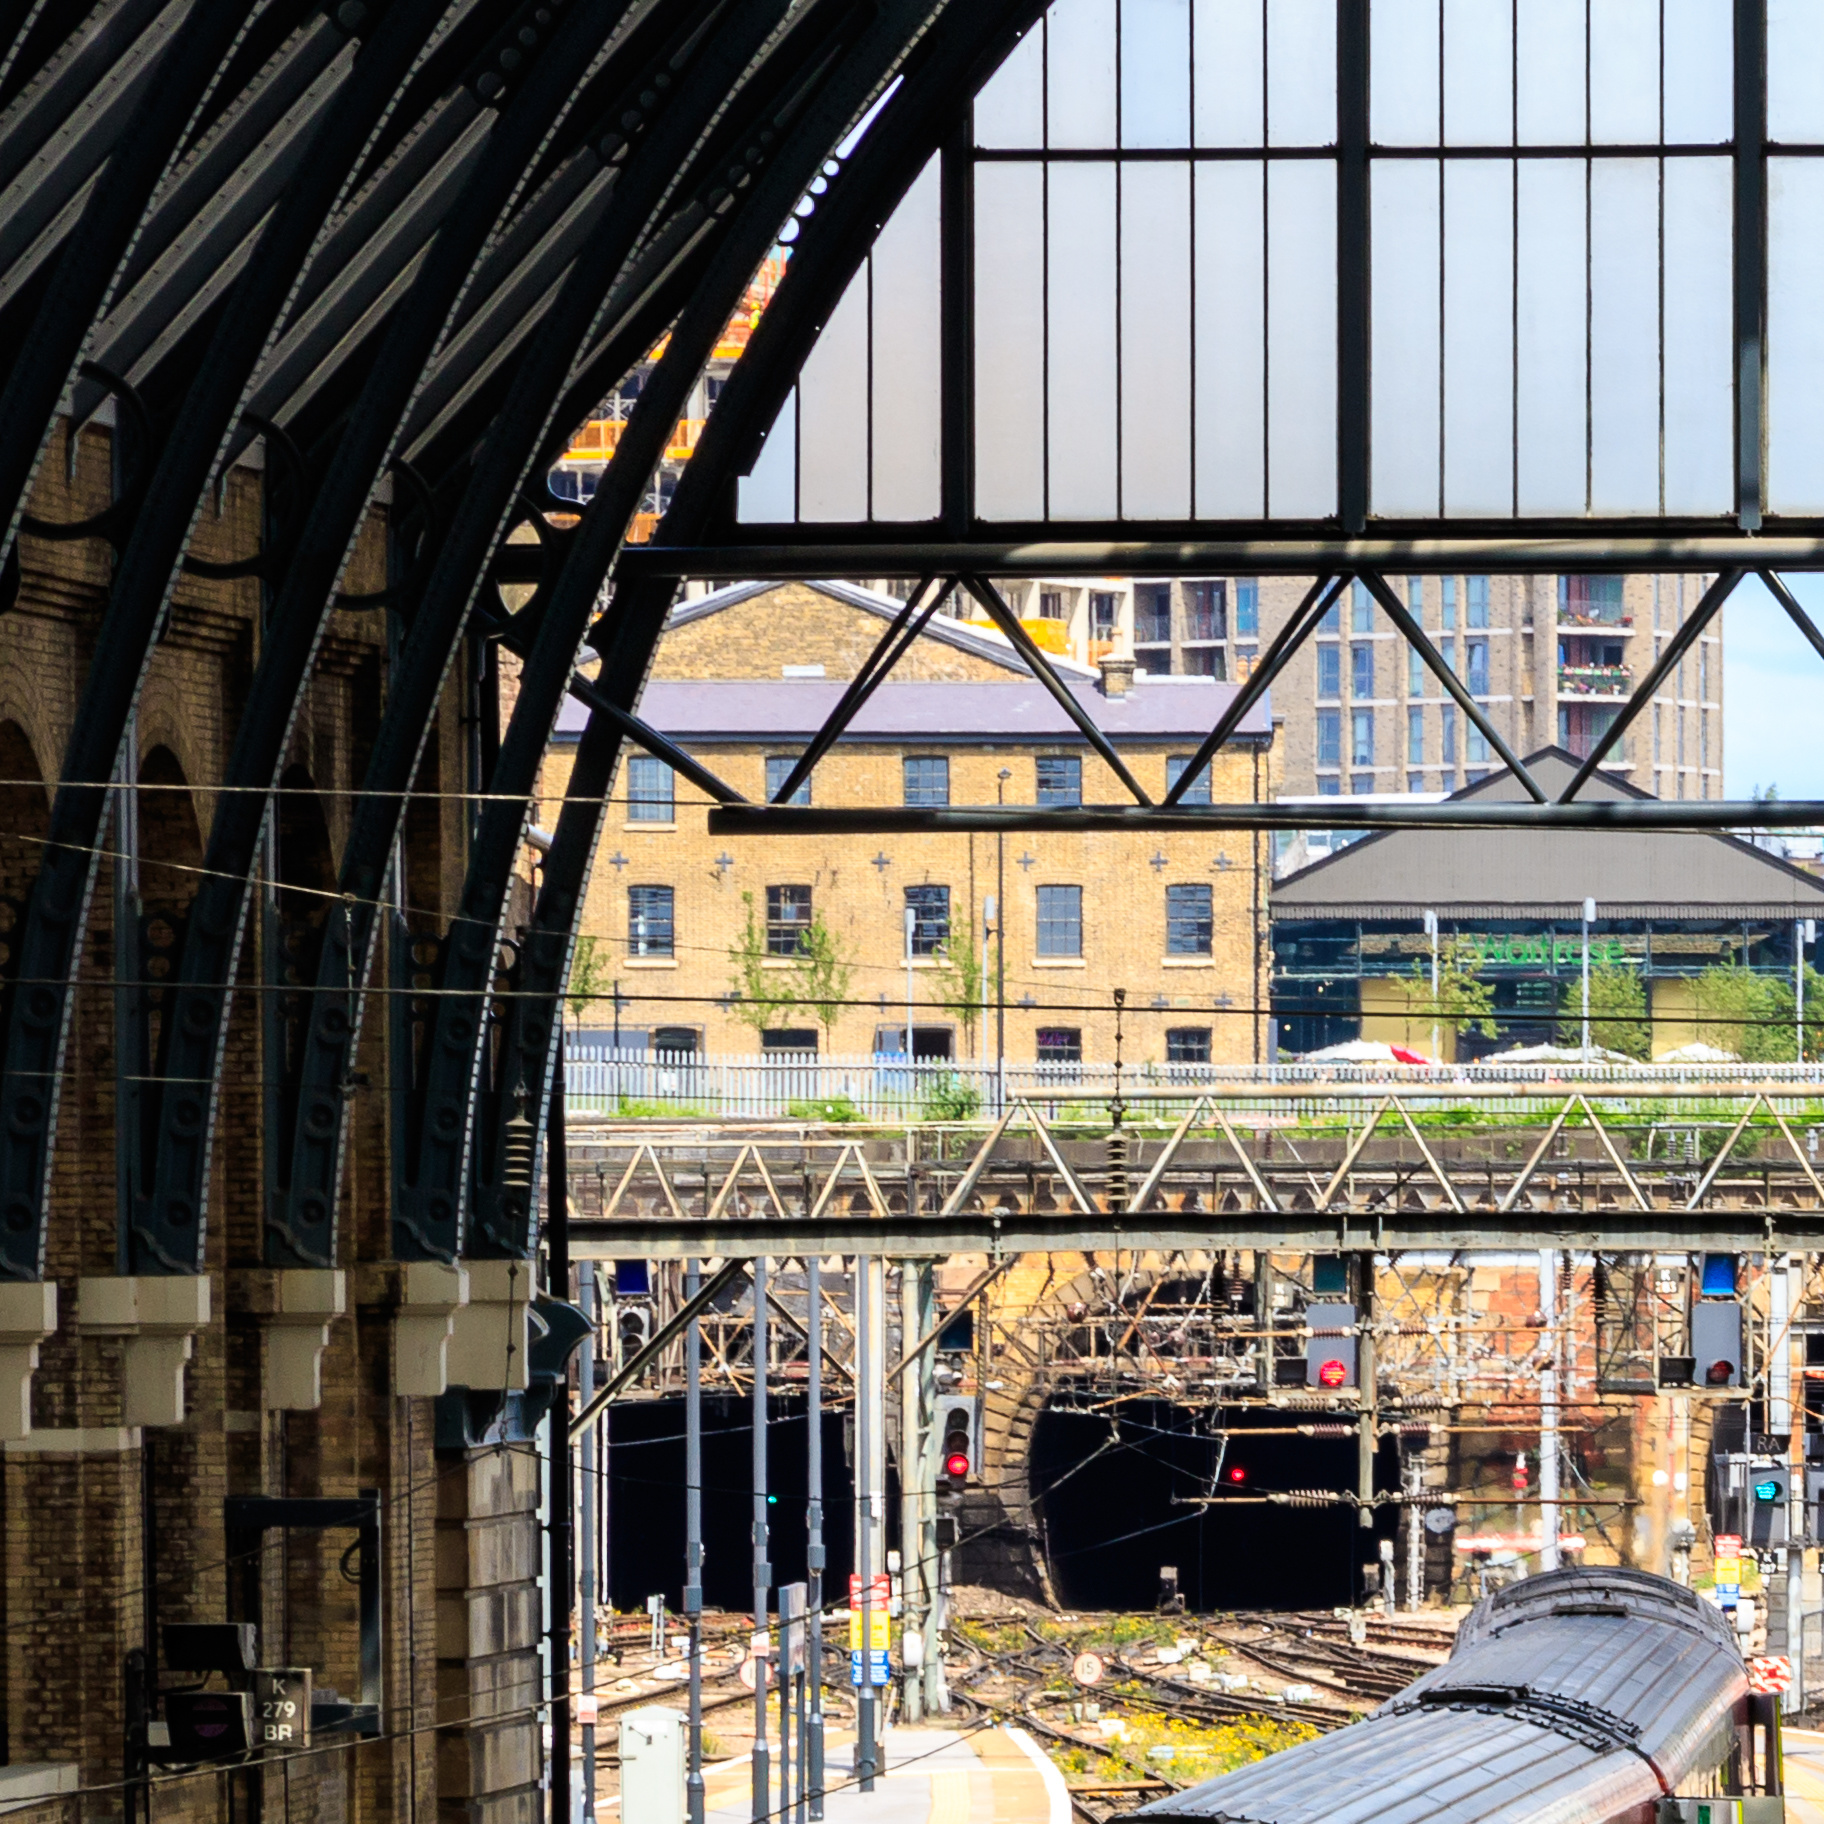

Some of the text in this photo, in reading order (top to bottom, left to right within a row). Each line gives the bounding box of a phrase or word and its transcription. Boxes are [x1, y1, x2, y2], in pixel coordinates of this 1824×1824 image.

[1470, 932, 1626, 966] Waitrose
[1081, 1661, 1094, 1675] 15
[273, 1678, 286, 1696] K
[262, 1700, 296, 1718] 279
[264, 1723, 292, 1741] BR
